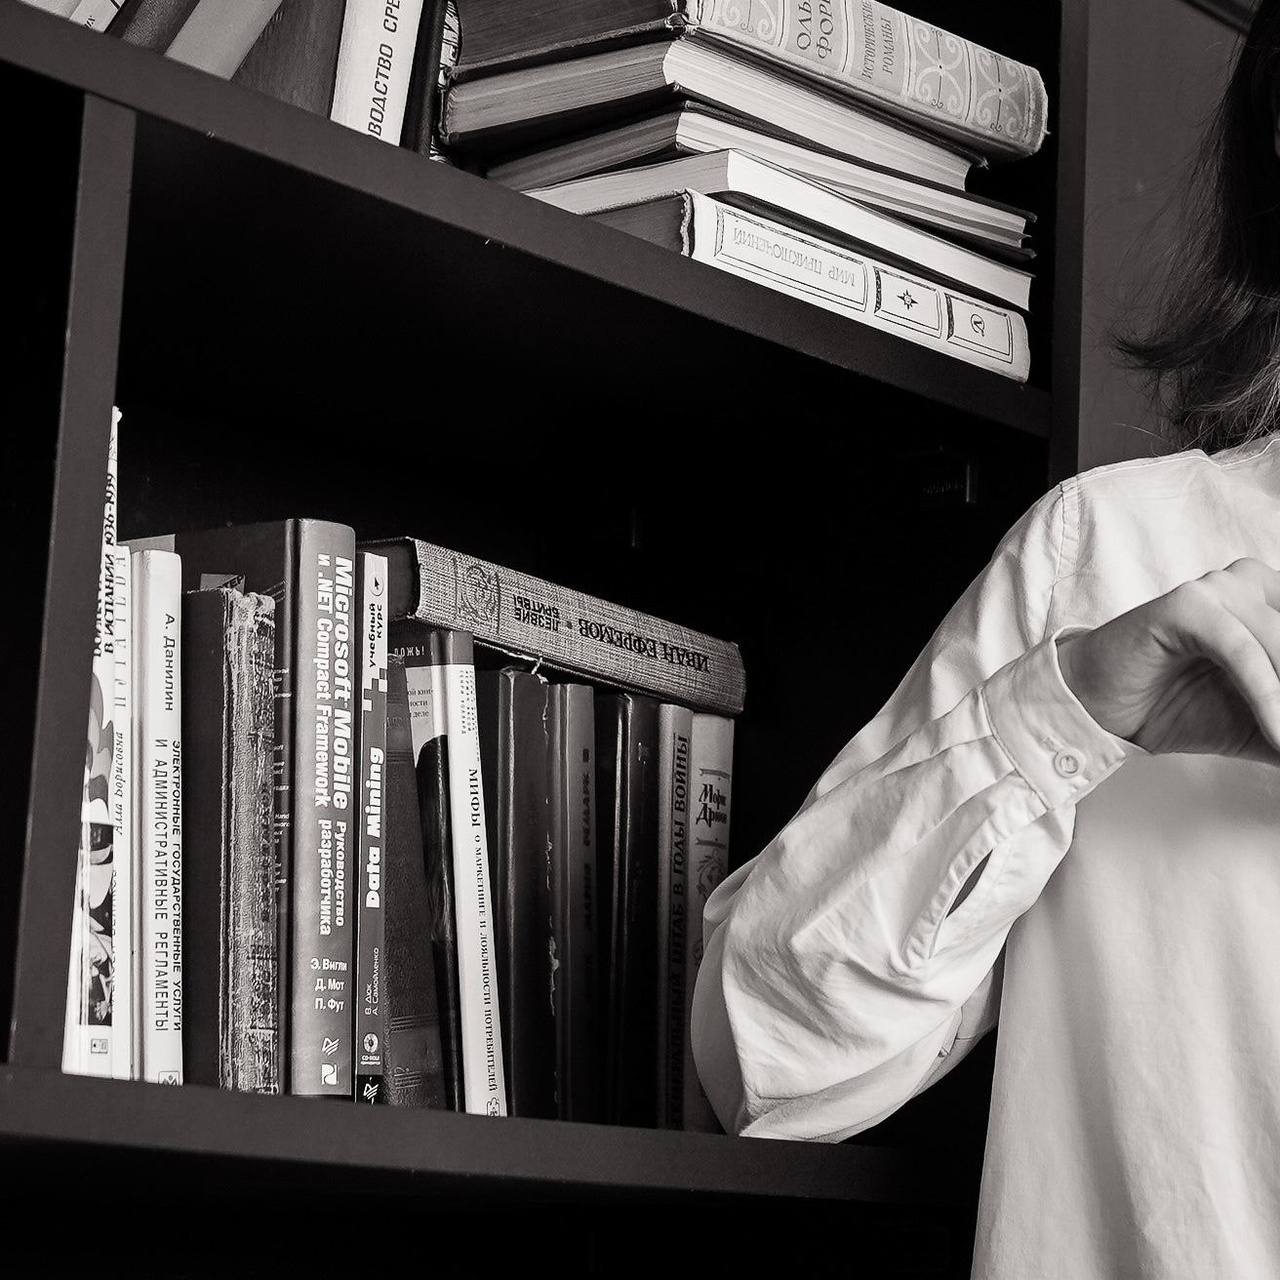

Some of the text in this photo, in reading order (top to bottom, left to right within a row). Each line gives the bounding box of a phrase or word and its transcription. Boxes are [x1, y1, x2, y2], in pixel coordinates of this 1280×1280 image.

[860, 0, 874, 80] ИСТОРИЧЕСКИЕ
[881, 16, 894, 76] РОМАНЫ
[368, 43, 394, 139] ВОДСТВО
[732, 226, 857, 288] МИР ПРИКЛЮЧЕНИЙ
[104, 554, 114, 637] ИСПАНИИ
[375, 603, 384, 640] курс
[512, 593, 559, 620] БРИТВЫ
[513, 606, 560, 632] ЛЕЗВИЕ
[163, 612, 176, 712] А. Данилин
[367, 602, 378, 668] учебный
[578, 617, 711, 674] ИВАН ЕФРЕМОВ
[312, 553, 333, 808] и .NET Compact Framework
[332, 555, 354, 810] Microsoft Mobile
[115, 732, 126, 798] Борисовна
[468, 768, 481, 828] МИФЫ
[673, 734, 688, 813] ВОЙНЫ
[364, 746, 384, 909] Data Mining
[672, 820, 686, 875] ГОДЫ
[153, 738, 168, 1032] И АДМИНИСТРАТИВНЫЕ РЕГЛАМЕНТЫ
[172, 740, 182, 1032] ЭЛЕКТРОННЫЕ ГОСУДАРСТВЕННЫЕ УСЛУГИ
[317, 818, 335, 936] разработчика
[332, 820, 347, 928] Руководство
[475, 847, 486, 917] МАРКЕТИНГЕ
[673, 883, 684, 896] В
[480, 932, 491, 1005] ЛОЯЛЬНОСТИ
[670, 904, 685, 965] ШТАБ
[314, 977, 345, 994] Д. Мот
[314, 996, 345, 1013] П. Фут
[484, 1009, 497, 1092] ПОТРЕБИТЕЛЕЙ
